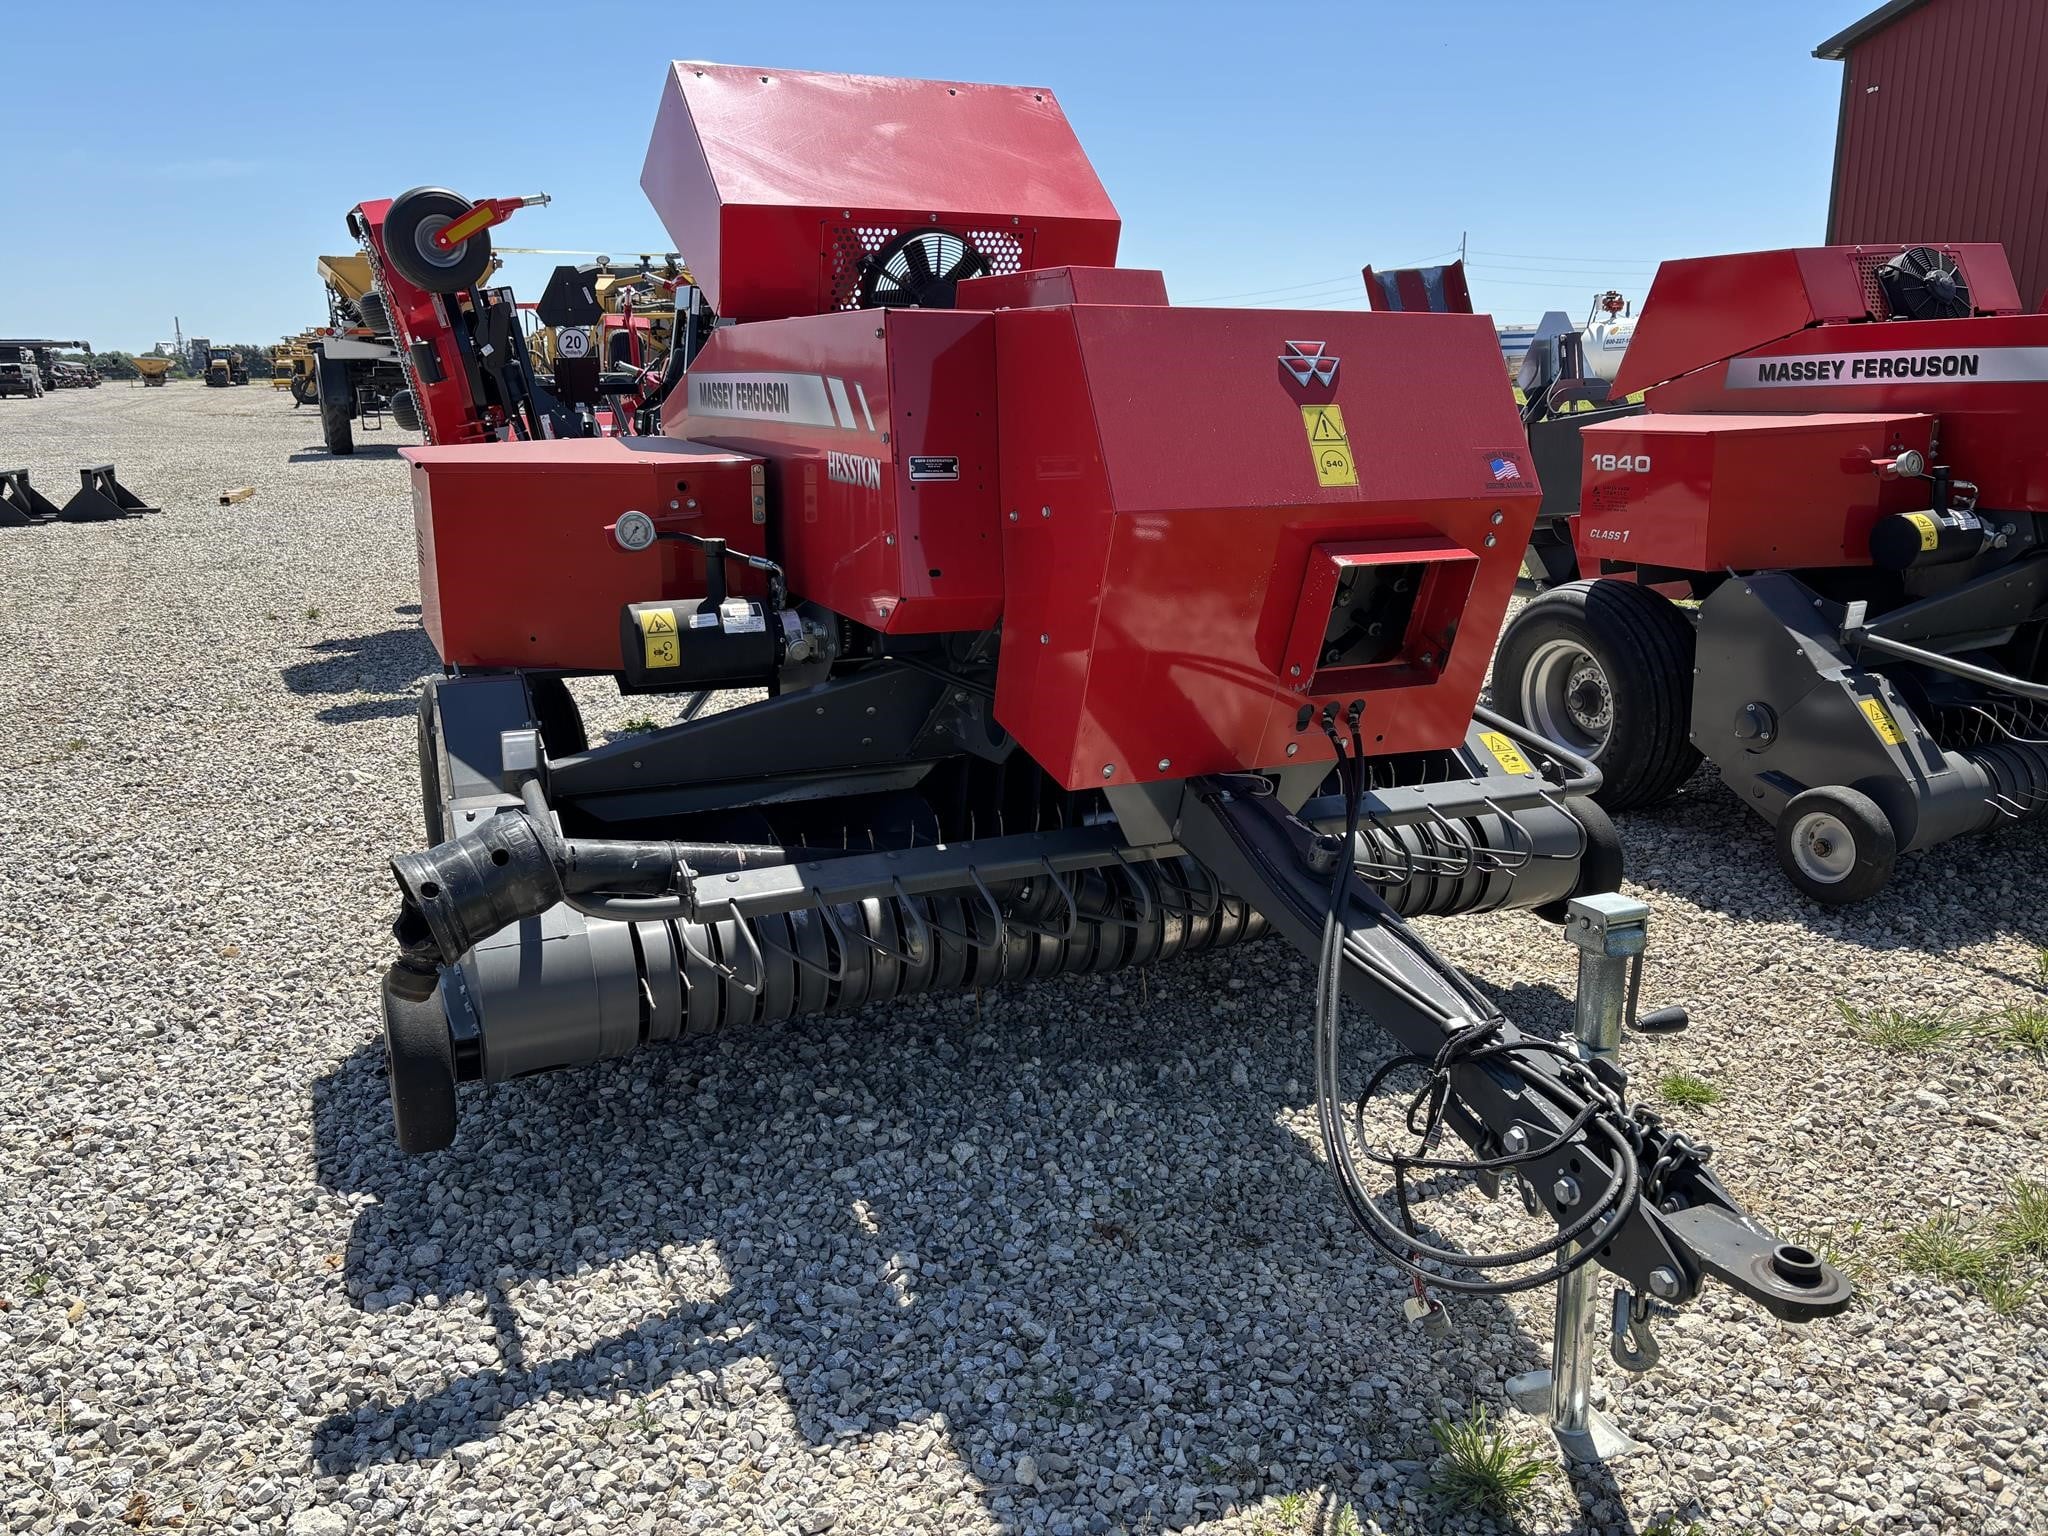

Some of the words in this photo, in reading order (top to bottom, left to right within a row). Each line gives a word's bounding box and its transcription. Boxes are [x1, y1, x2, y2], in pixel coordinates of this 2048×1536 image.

[565, 335, 582, 349] 20
[1758, 360, 1845, 382] MASSEY
[1851, 355, 1980, 379] FERGUSON
[699, 382, 734, 410] MASSEY
[736, 383, 790, 414] FERGUSON
[828, 450, 881, 490] HESSTON
[1326, 460, 1343, 468] 540
[1591, 454, 1651, 473] 1840
[1590, 529, 1622, 541] CLASS
[1622, 530, 1630, 543] 1
